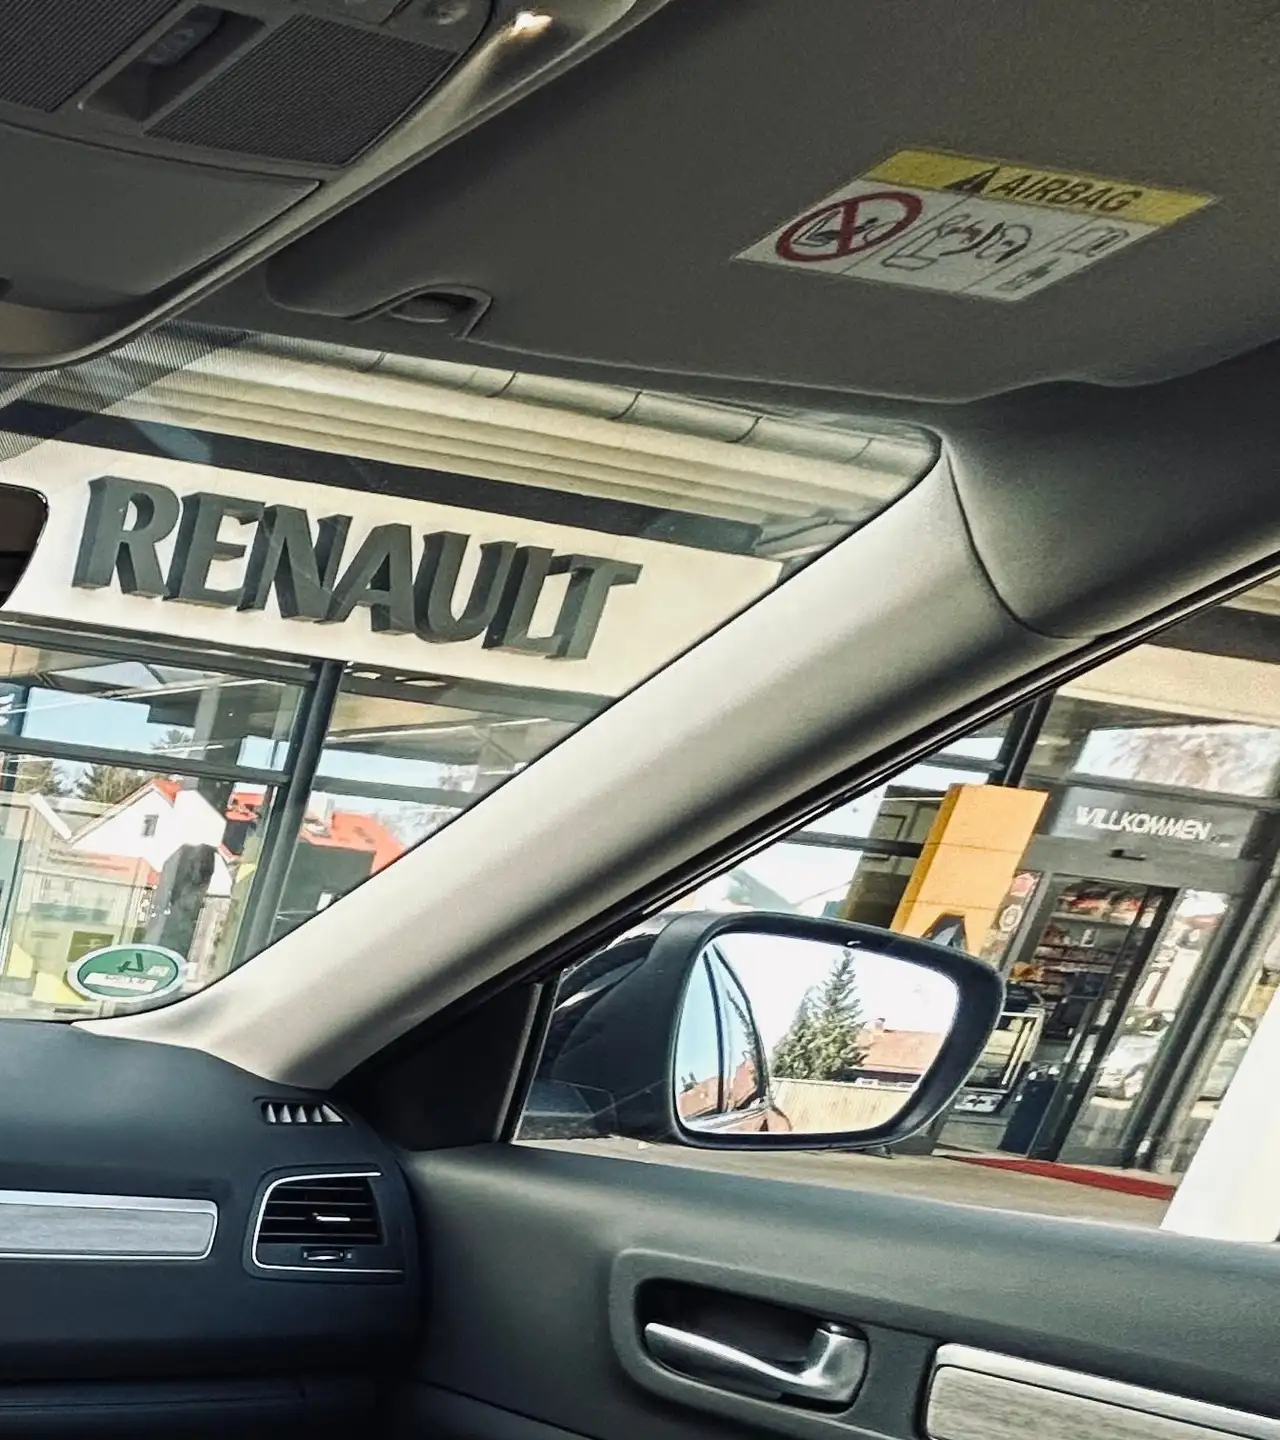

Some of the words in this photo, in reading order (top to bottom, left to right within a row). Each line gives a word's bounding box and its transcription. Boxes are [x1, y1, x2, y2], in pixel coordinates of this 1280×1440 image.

[990, 174, 1143, 212] AIRBAG
[71, 475, 643, 660] RENAULT
[1075, 805, 1213, 840] WILLKOMMEN
